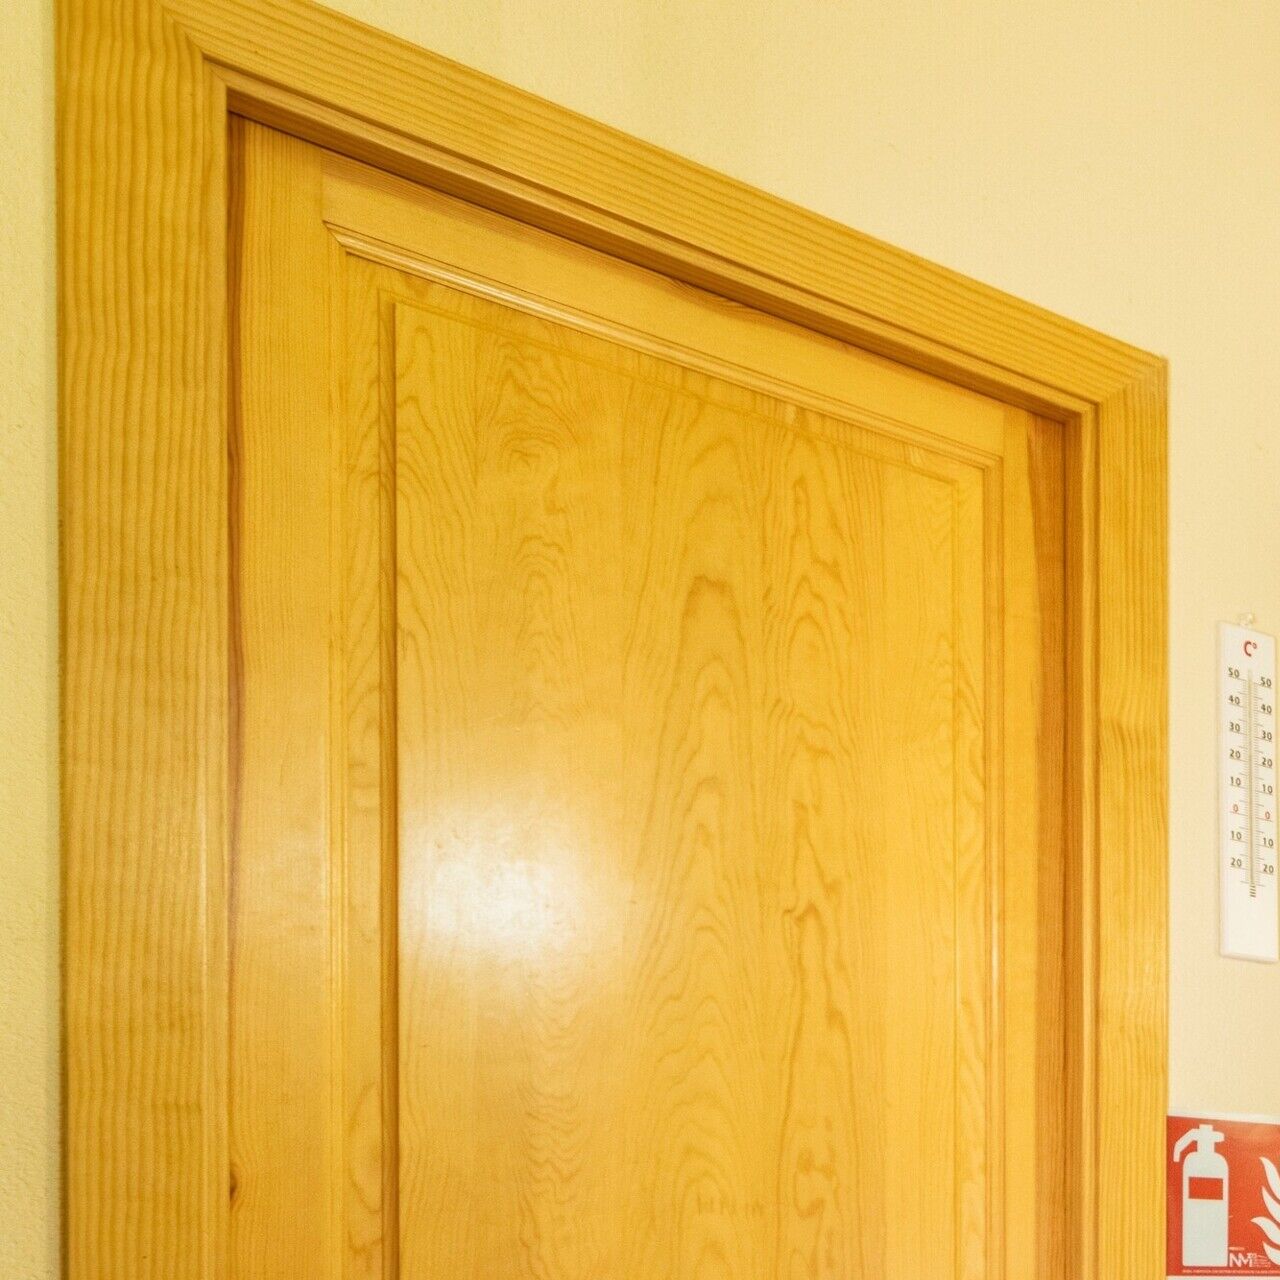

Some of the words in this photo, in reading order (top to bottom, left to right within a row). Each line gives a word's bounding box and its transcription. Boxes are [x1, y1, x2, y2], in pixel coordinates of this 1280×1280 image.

[1228, 667, 1240, 678] 50
[1260, 676, 1272, 687] 50
[1228, 695, 1241, 705] 40
[1261, 704, 1272, 714] 40
[1229, 722, 1241, 732] 30
[1261, 730, 1273, 740] 30
[1229, 749, 1241, 759] 20
[1261, 757, 1273, 768] 20
[1230, 776, 1241, 786] 10
[1262, 784, 1273, 794] 10
[1232, 804, 1239, 813] 0
[1264, 811, 1271, 820] 0
[1230, 831, 1242, 840] 10
[1263, 838, 1274, 847] 10
[1230, 857, 1242, 868] 20
[1263, 864, 1275, 874] 20
